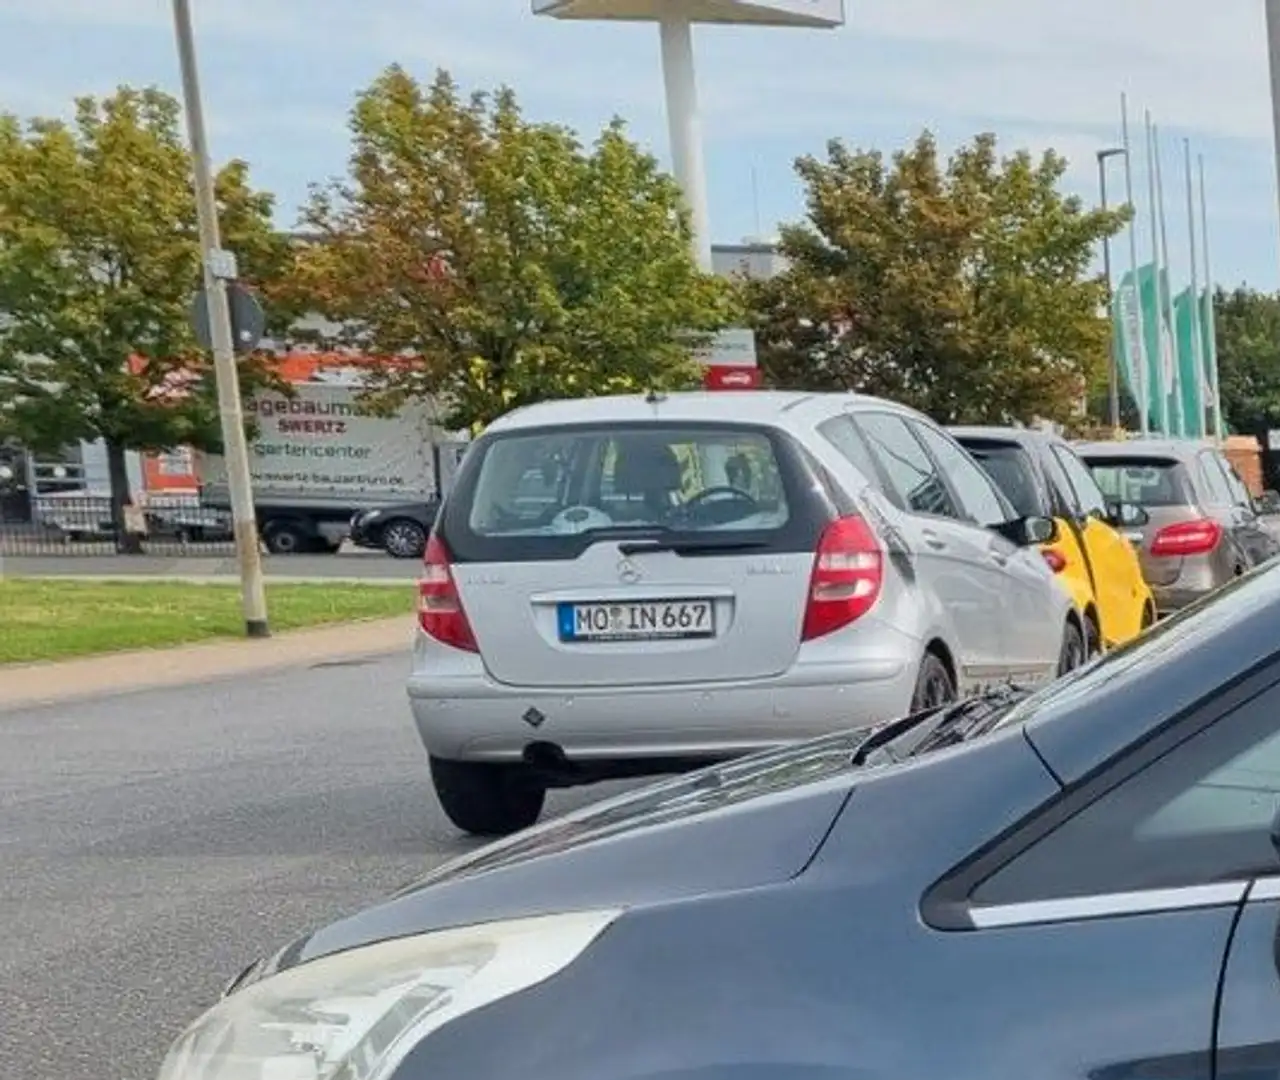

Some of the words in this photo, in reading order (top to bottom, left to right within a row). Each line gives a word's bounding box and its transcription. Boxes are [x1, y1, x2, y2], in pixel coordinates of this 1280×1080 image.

[278, 418, 347, 434] SWERTZ
[576, 606, 608, 631] MO
[628, 604, 656, 629] IN
[662, 603, 706, 628] 667
